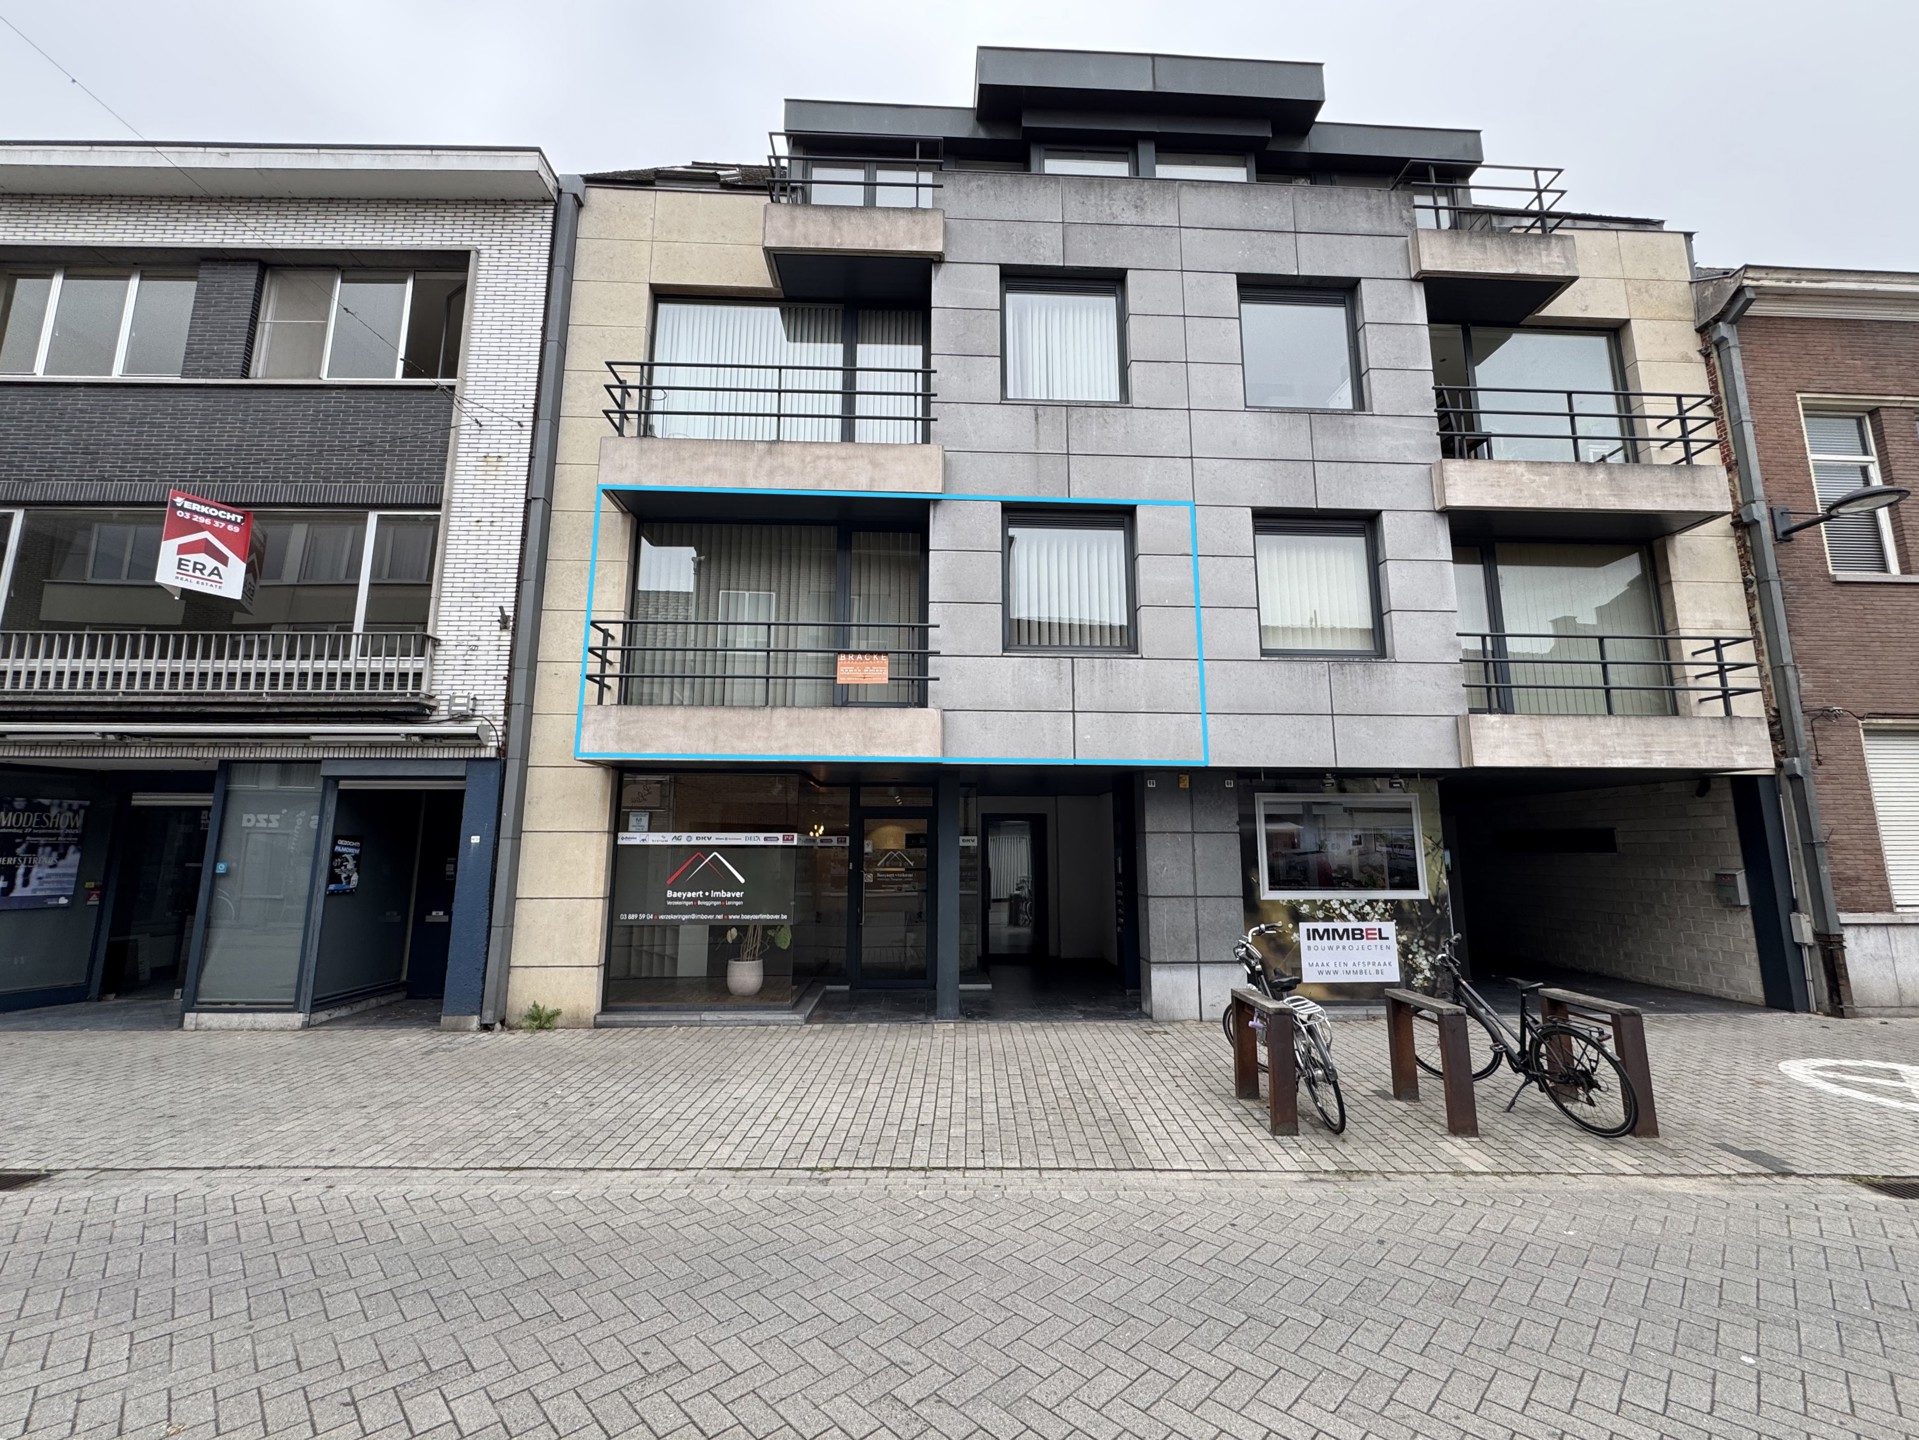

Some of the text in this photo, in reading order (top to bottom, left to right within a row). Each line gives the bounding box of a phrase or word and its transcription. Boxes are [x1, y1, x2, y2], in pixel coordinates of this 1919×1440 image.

[173, 497, 243, 523] VERKOCHT
[176, 510, 240, 533] 03 296 37 69
[176, 557, 223, 580] ERA
[175, 575, 223, 590] REAL ESTATE
[840, 653, 887, 661] BRACKE
[0, 811, 81, 829] MODESHOW
[666, 890, 745, 900] Baeyaert Imbaver
[1306, 928, 1390, 941] IMMBEL
